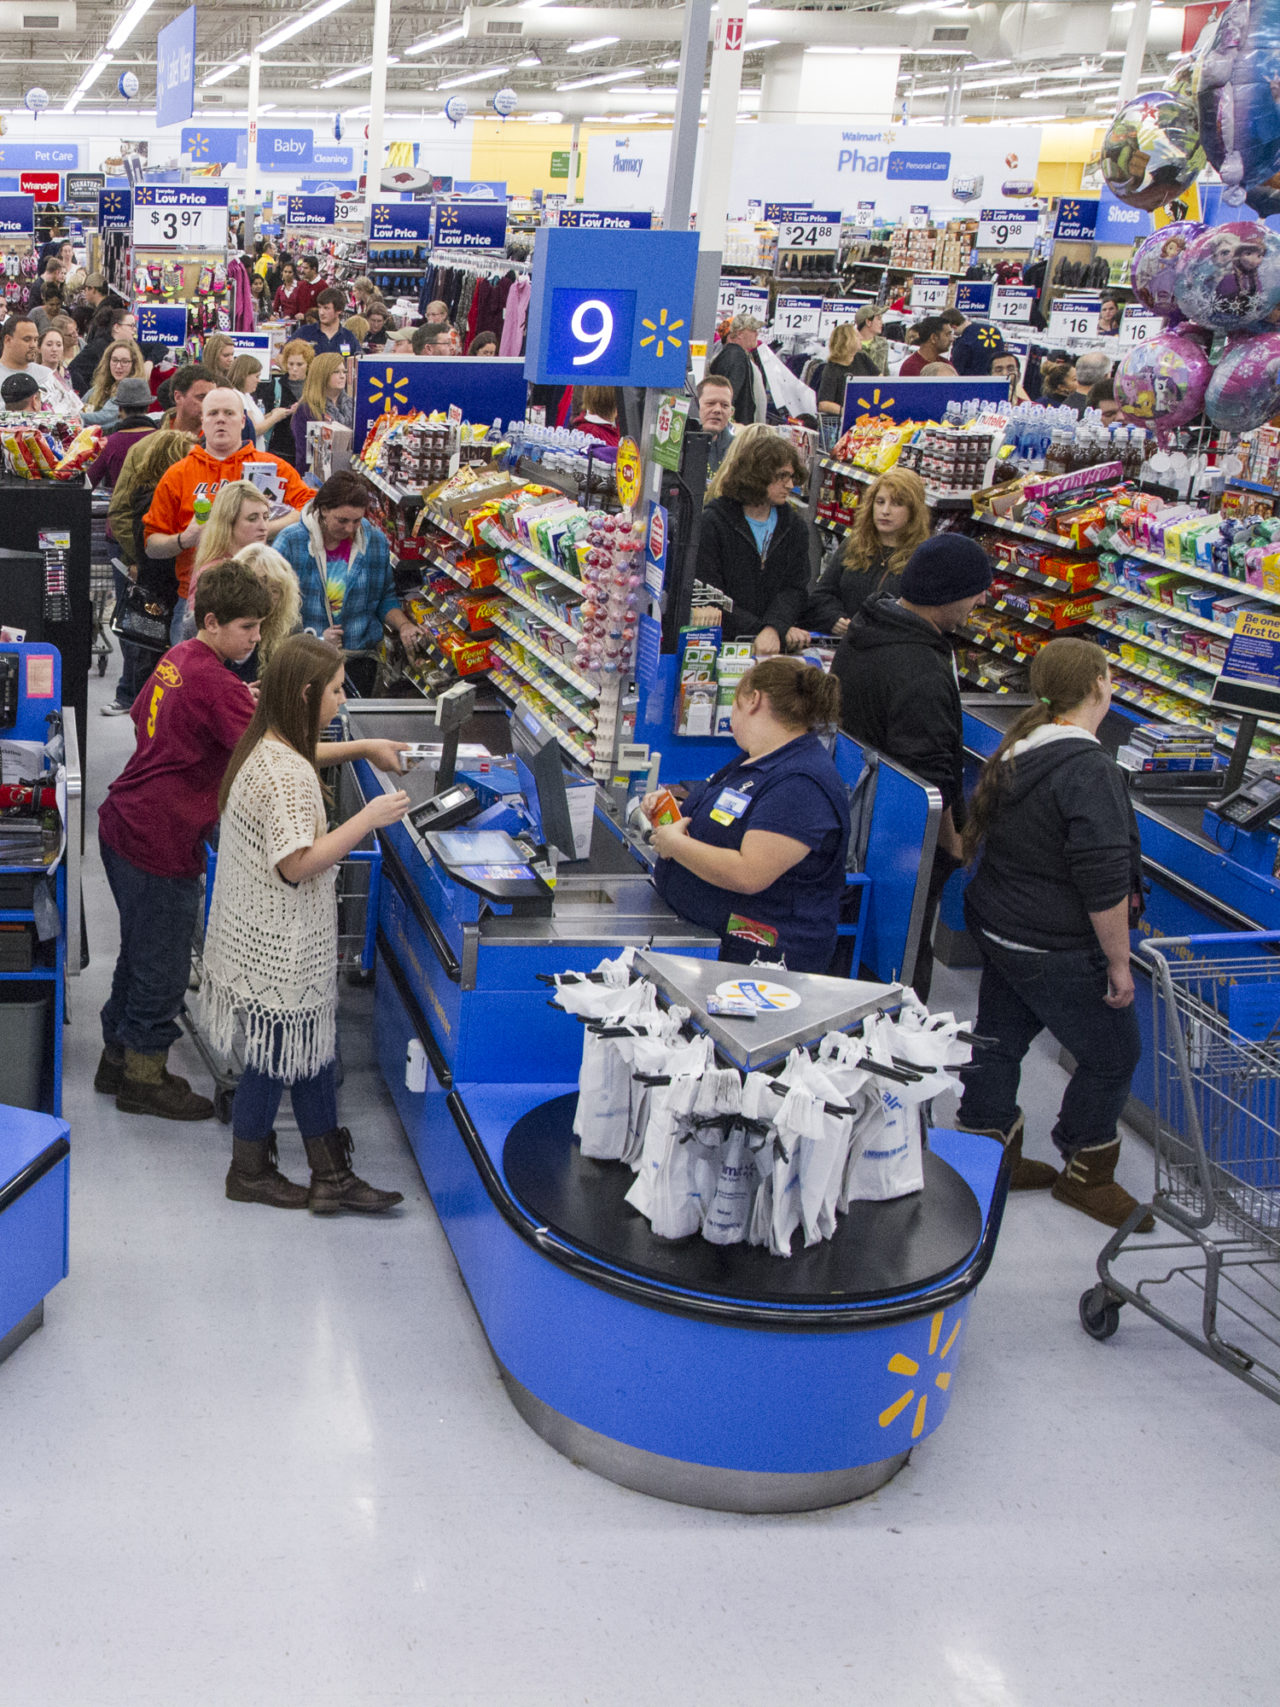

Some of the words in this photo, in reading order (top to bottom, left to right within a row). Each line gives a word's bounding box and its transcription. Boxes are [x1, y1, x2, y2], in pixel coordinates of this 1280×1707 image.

[841, 131, 882, 143] Walmart
[274, 138, 307, 156] Baby
[34, 150, 51, 161] Pet
[53, 150, 74, 161] Care
[313, 153, 349, 166] Cleaning
[837, 149, 890, 172] Phar
[612, 153, 644, 178] Pharmacy
[905, 161, 932, 171] Personal
[933, 162, 947, 171] Care
[22, 180, 59, 193] Wrangler
[155, 188, 176, 196] Everyday
[155, 193, 177, 204] Low
[179, 192, 208, 205] Price
[104, 214, 126, 222] Everyday
[289, 215, 306, 224] Low
[307, 215, 327, 224] Price
[793, 213, 806, 222] Low
[807, 213, 828, 223] Price
[992, 211, 1007, 221] Low
[1007, 212, 1027, 222] Price
[1107, 204, 1141, 224] Shoes
[579, 216, 602, 228] Low
[603, 217, 632, 229] Price
[373, 228, 393, 238] Low
[394, 228, 418, 239] Price
[1058, 225, 1079, 237] Low
[1080, 226, 1096, 238] Pri
[438, 233, 462, 245] Low
[463, 234, 492, 246] Price
[787, 300, 798, 308] Low
[798, 301, 811, 309] Price
[844, 306, 858, 314] Price
[958, 302, 970, 310] Low
[970, 302, 986, 311] Price
[1062, 304, 1074, 312] Low
[1074, 305, 1089, 313] Price
[141, 334, 158, 343] Low
[158, 333, 179, 343] Price
[570, 299, 615, 367] 9
[239, 340, 256, 348] Price
[979, 413, 1008, 429] nutella
[1244, 613, 1260, 625] Be
[1260, 617, 1280, 628] one
[1241, 624, 1267, 637] first
[1267, 629, 1280, 640] to
